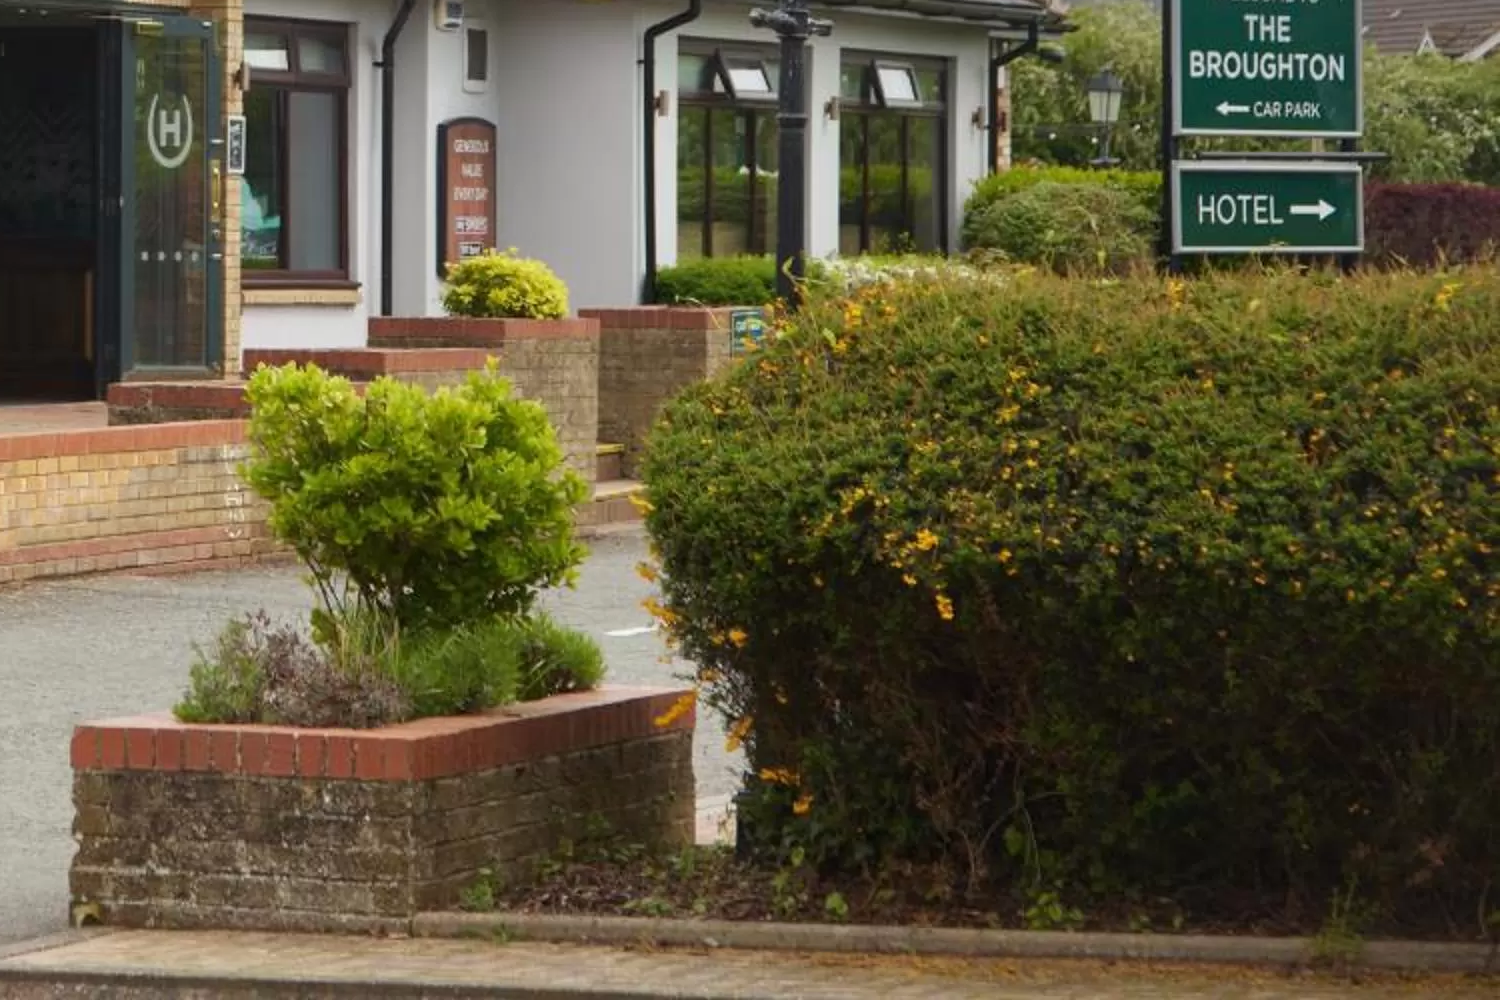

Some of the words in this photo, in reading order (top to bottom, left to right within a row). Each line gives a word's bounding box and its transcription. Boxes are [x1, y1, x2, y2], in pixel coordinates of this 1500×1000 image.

[1243, 13, 1292, 43] THE
[1189, 50, 1345, 82] BROUGHTON
[1253, 101, 1283, 119] CAR
[1285, 102, 1321, 119] PARK
[159, 109, 181, 148] H
[1198, 194, 1284, 225] HOTEL
